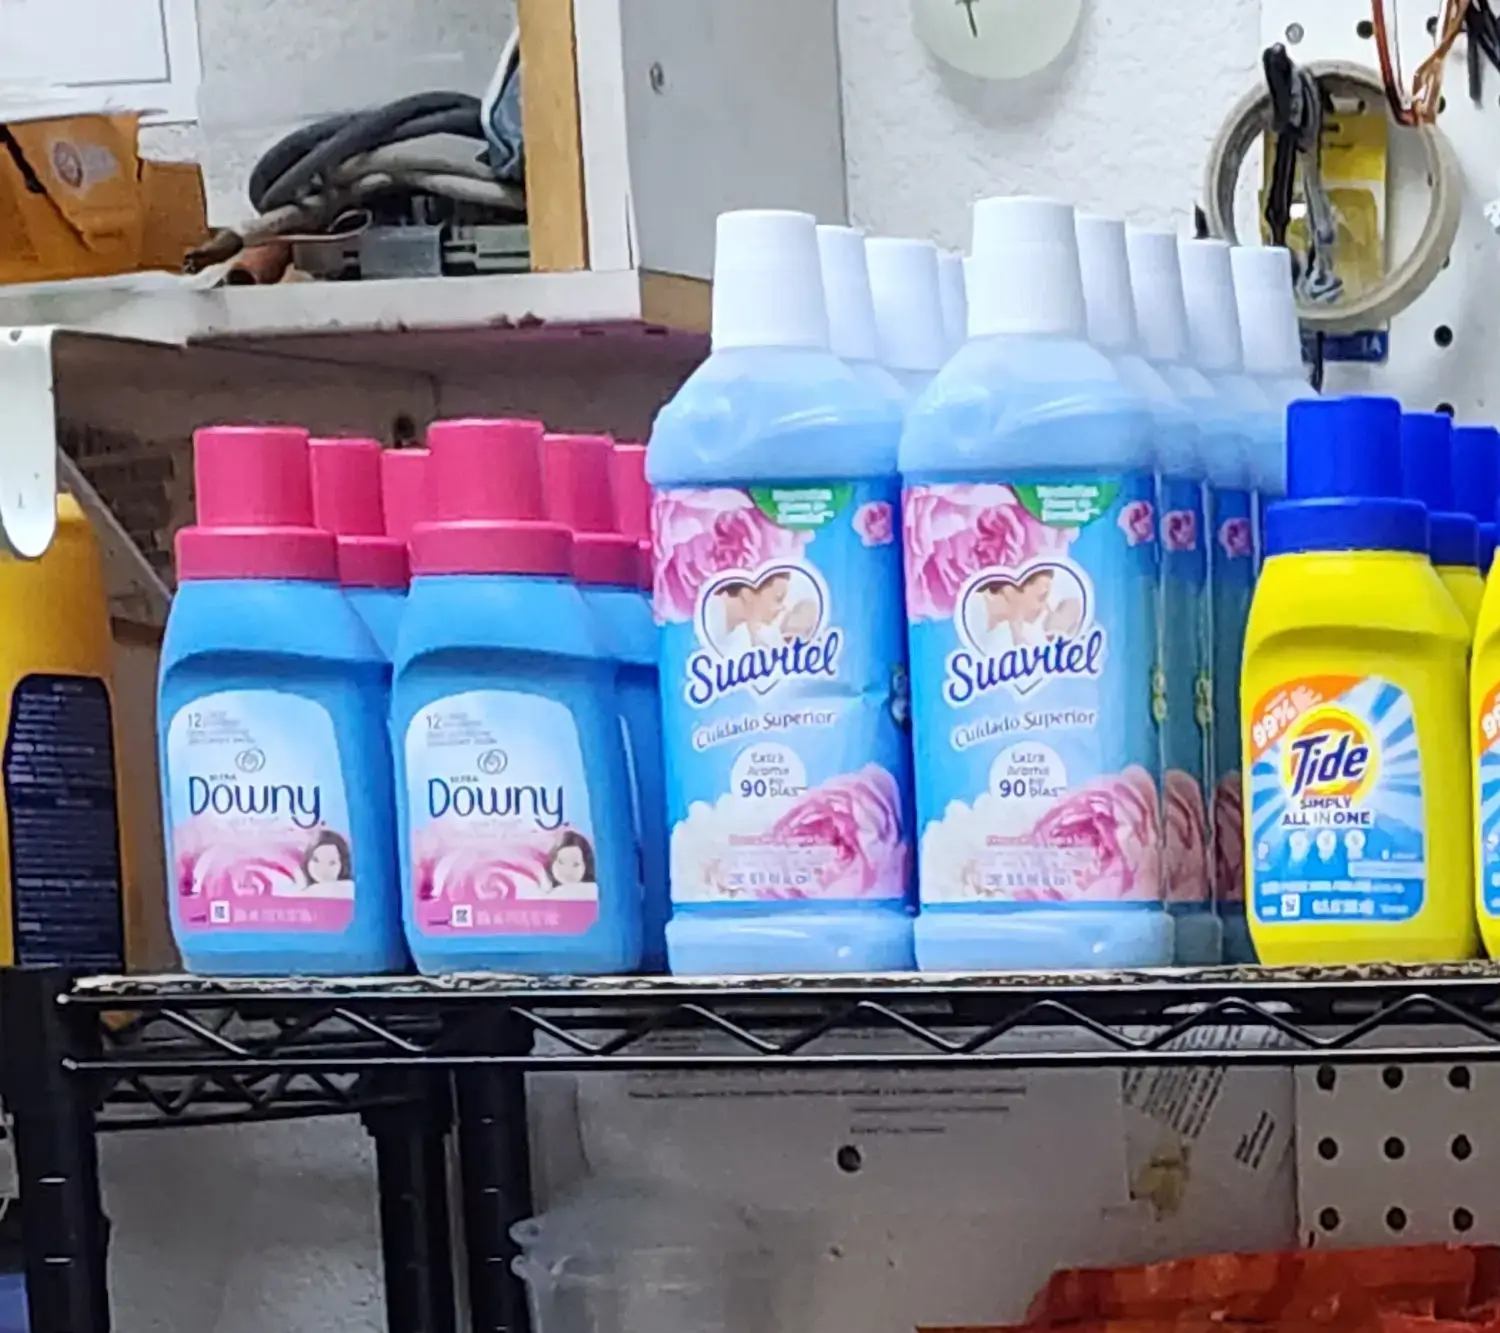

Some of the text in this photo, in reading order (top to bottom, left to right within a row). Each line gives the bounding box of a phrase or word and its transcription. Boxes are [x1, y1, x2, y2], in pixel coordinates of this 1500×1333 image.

[690, 631, 840, 704] Suavitel
[949, 630, 1103, 702] Suavitel
[426, 714, 441, 729] 12
[762, 711, 835, 730] Superior
[1023, 710, 1096, 730] Superior
[1291, 734, 1369, 797] Tide
[740, 778, 767, 798] 90
[999, 778, 1026, 798] 90
[188, 775, 321, 830] Downy
[427, 777, 564, 831] Downy
[1300, 797, 1352, 810] SIMPLY
[1281, 812, 1310, 826] ALL
[1333, 811, 1371, 825] ONE
